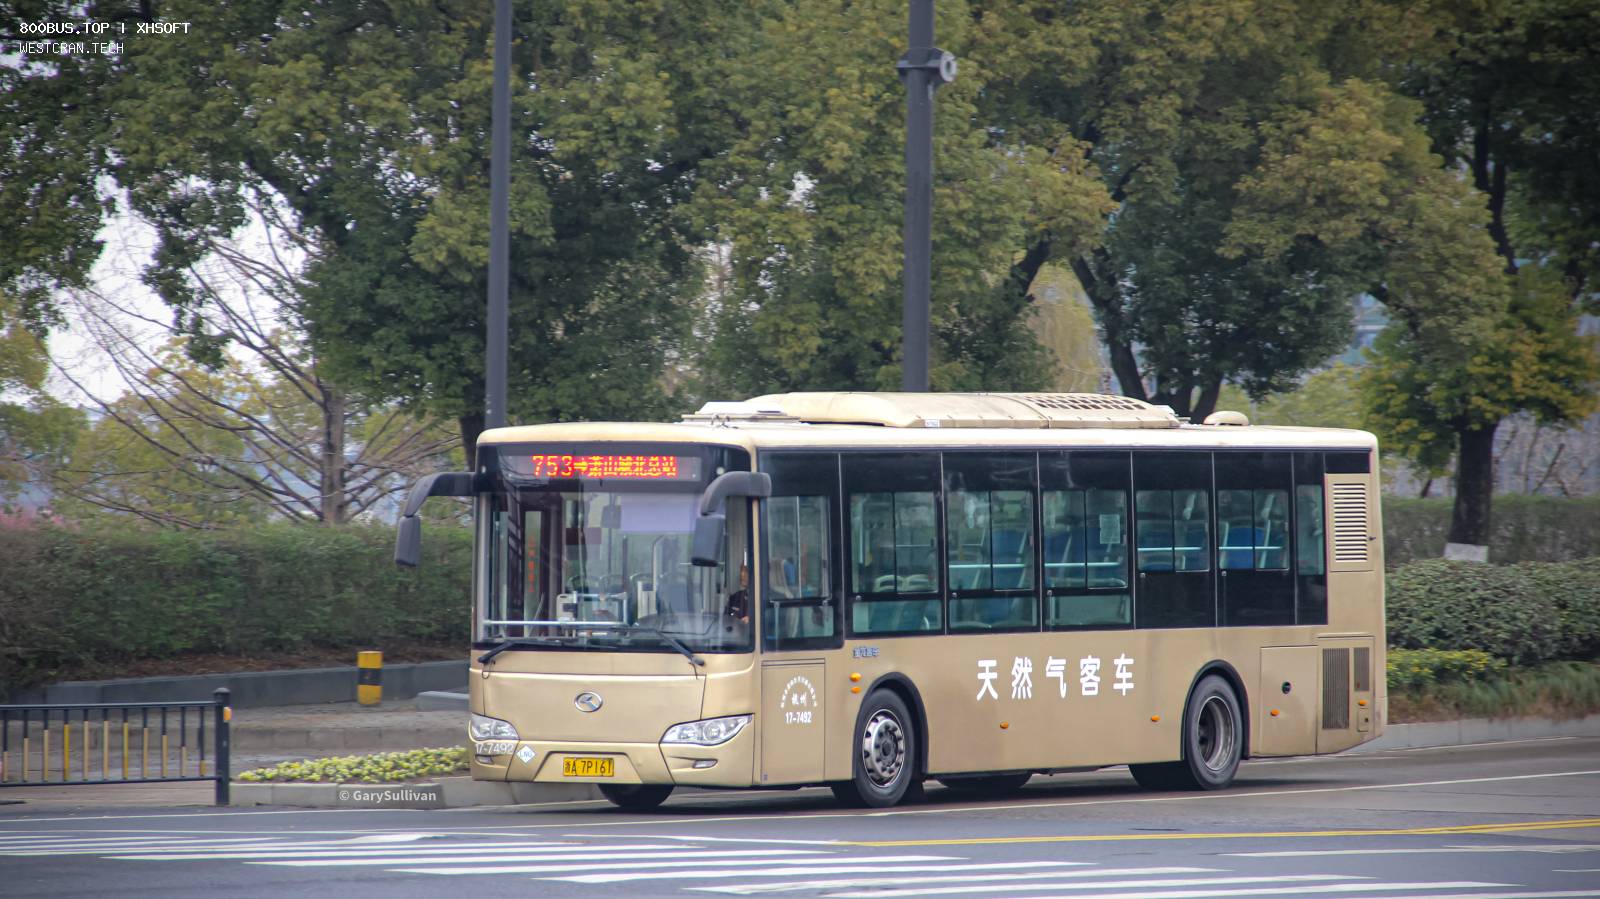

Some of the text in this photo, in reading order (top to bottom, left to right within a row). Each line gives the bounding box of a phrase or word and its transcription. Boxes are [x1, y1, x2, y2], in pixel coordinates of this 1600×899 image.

[532, 455, 574, 477] 753
[976, 652, 1135, 701] 天然气客车
[785, 711, 812, 724] 17-7492
[475, 742, 514, 755] 17-7492
[519, 750, 533, 758] LNG
